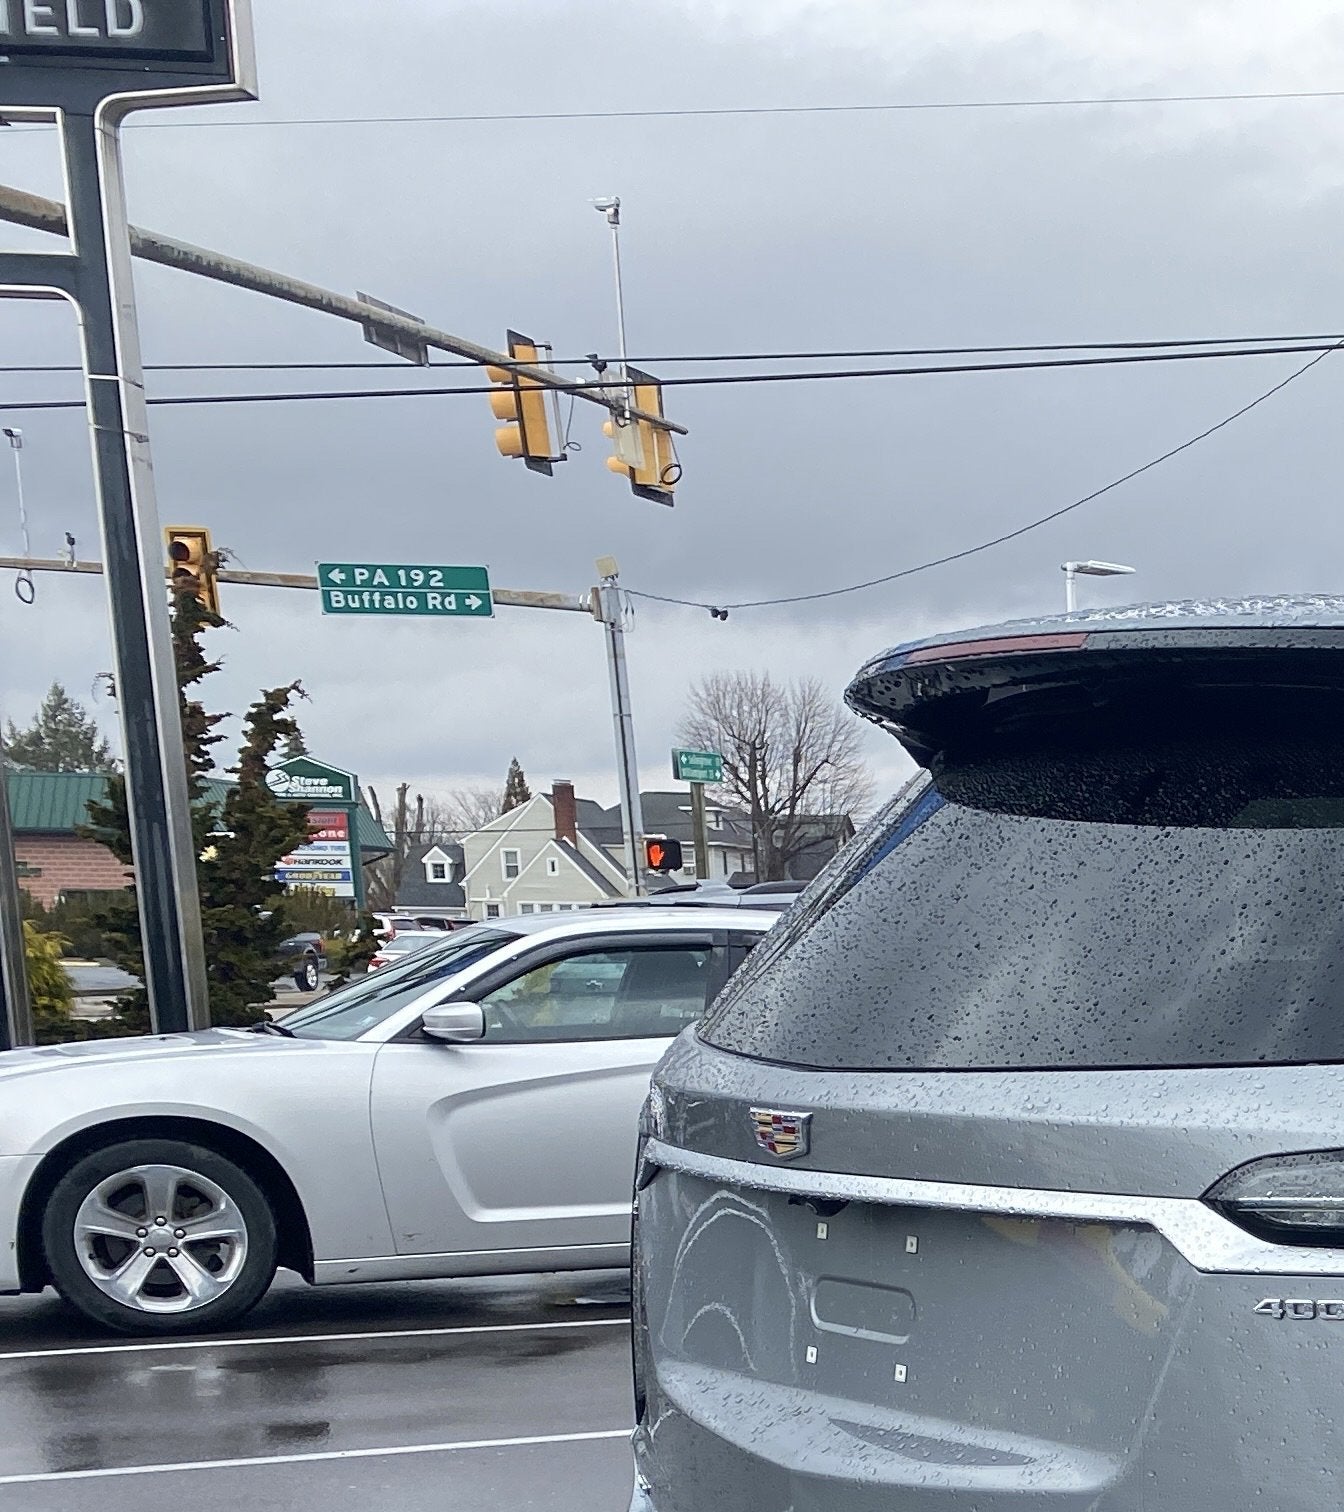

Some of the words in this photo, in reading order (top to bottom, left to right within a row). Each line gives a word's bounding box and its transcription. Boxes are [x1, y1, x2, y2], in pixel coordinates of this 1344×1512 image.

[354, 568, 390, 586] PA
[398, 569, 444, 587] 192
[330, 591, 418, 609] Buffalo
[426, 592, 457, 610] Rd
[291, 776, 328, 786] Steve
[288, 785, 343, 794] Shannon
